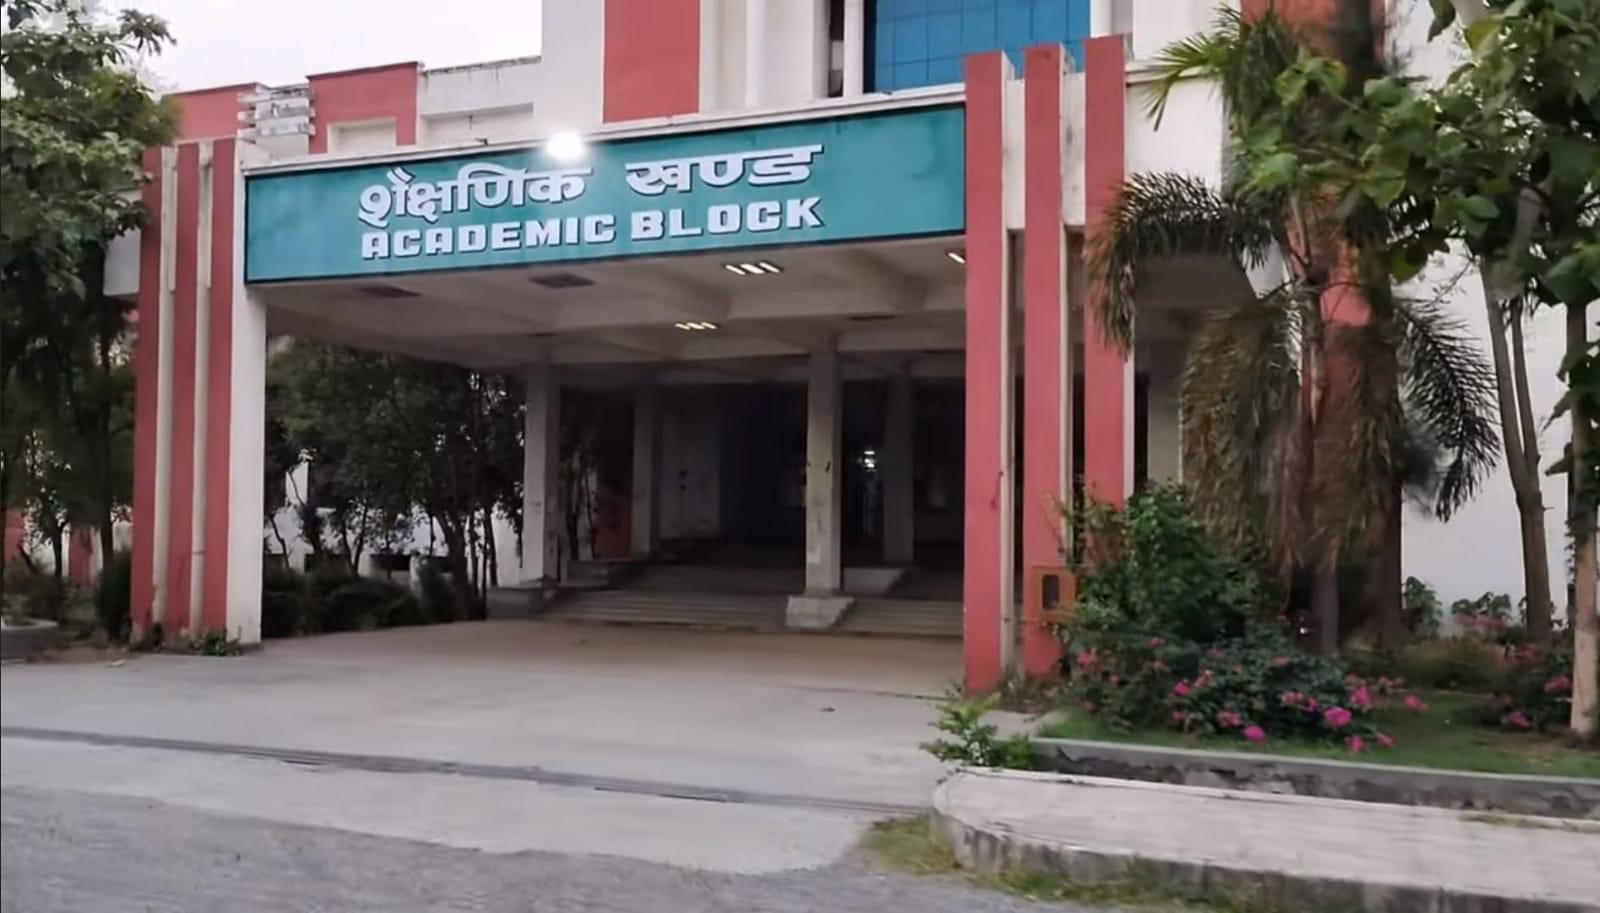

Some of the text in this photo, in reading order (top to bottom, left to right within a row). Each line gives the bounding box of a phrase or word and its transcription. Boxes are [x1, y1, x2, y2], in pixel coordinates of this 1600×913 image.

[358, 144, 824, 227] शैक्षणिक खण्ड
[361, 197, 824, 260] ACADEMIC BLOCK
